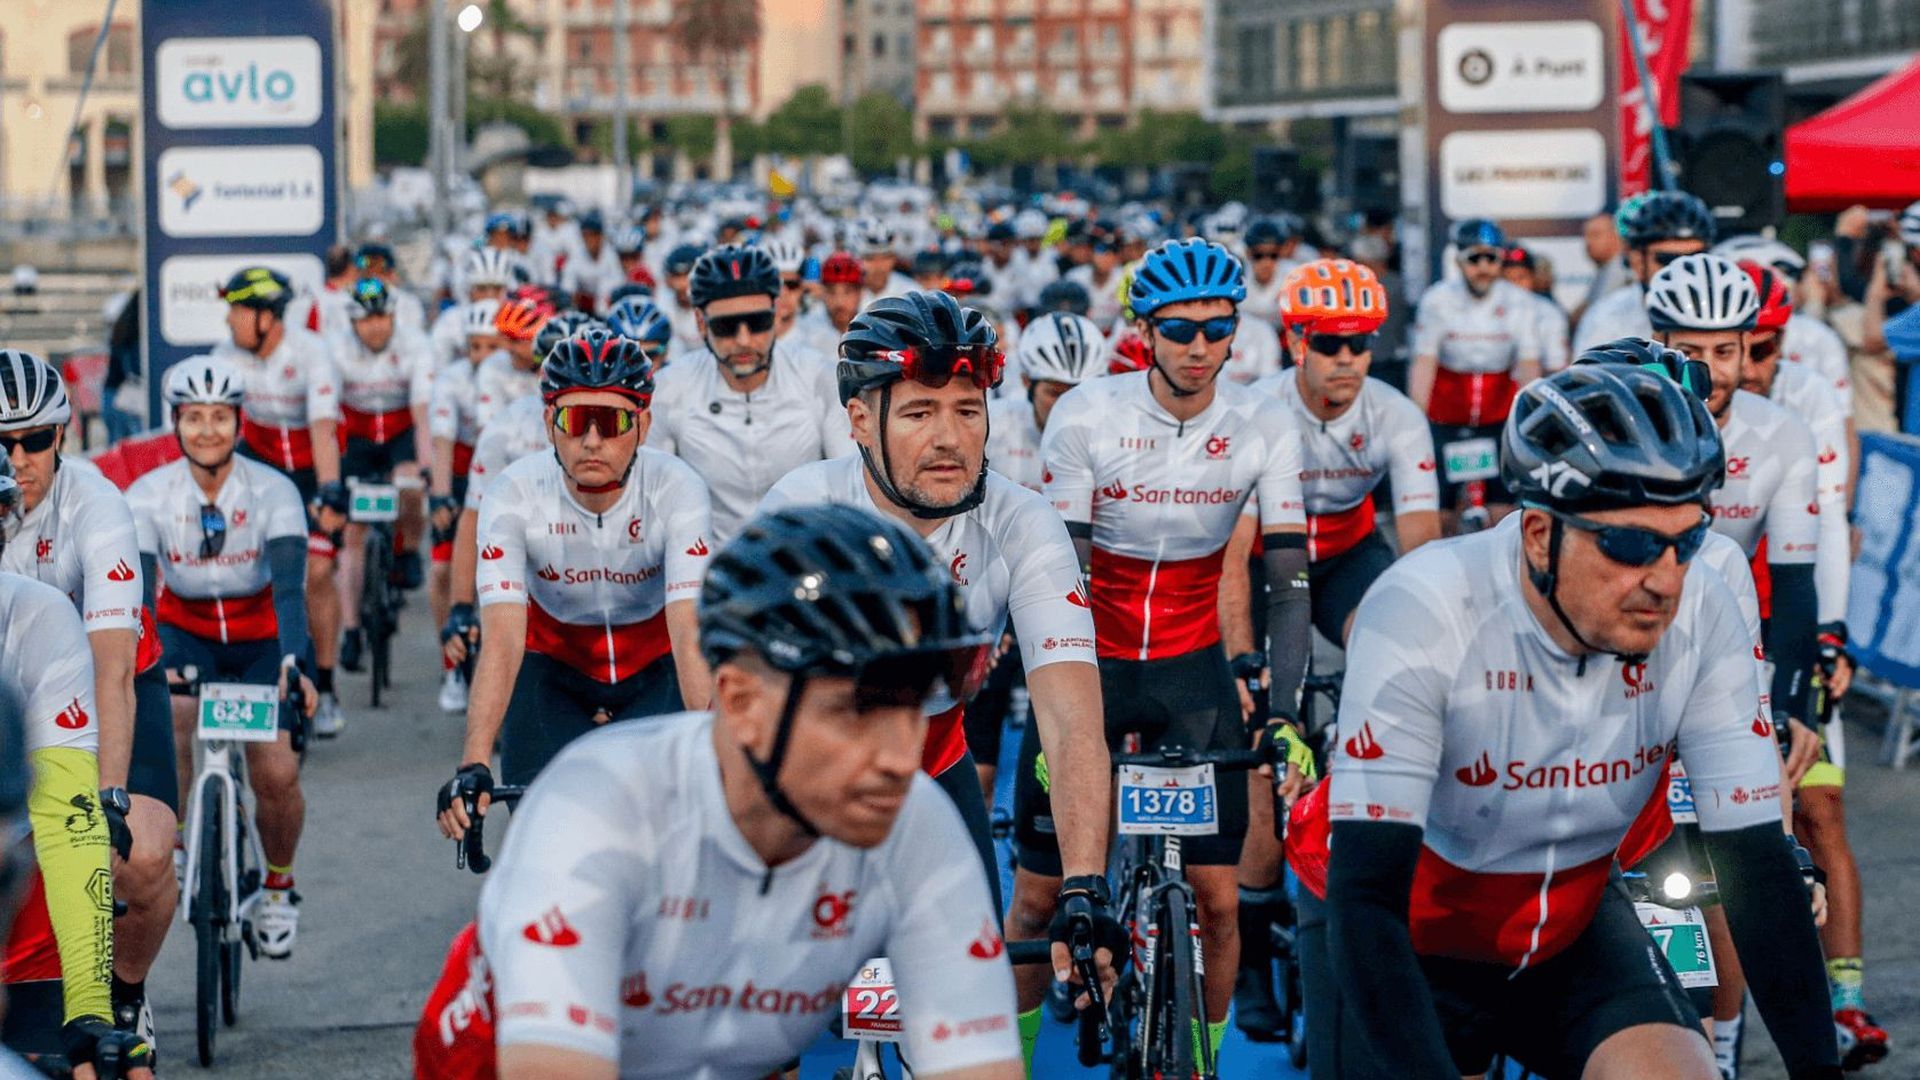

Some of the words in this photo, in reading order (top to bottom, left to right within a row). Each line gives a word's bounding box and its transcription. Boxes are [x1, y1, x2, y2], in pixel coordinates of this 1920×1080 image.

[183, 61, 295, 103] avlo
[1131, 483, 1243, 505] Santander
[563, 562, 663, 586] Santander
[1485, 669, 1535, 692] GOBIK
[212, 701, 254, 722] 624
[1128, 788, 1196, 815] 1378
[1694, 930, 1705, 949] km
[861, 967, 880, 980] GF
